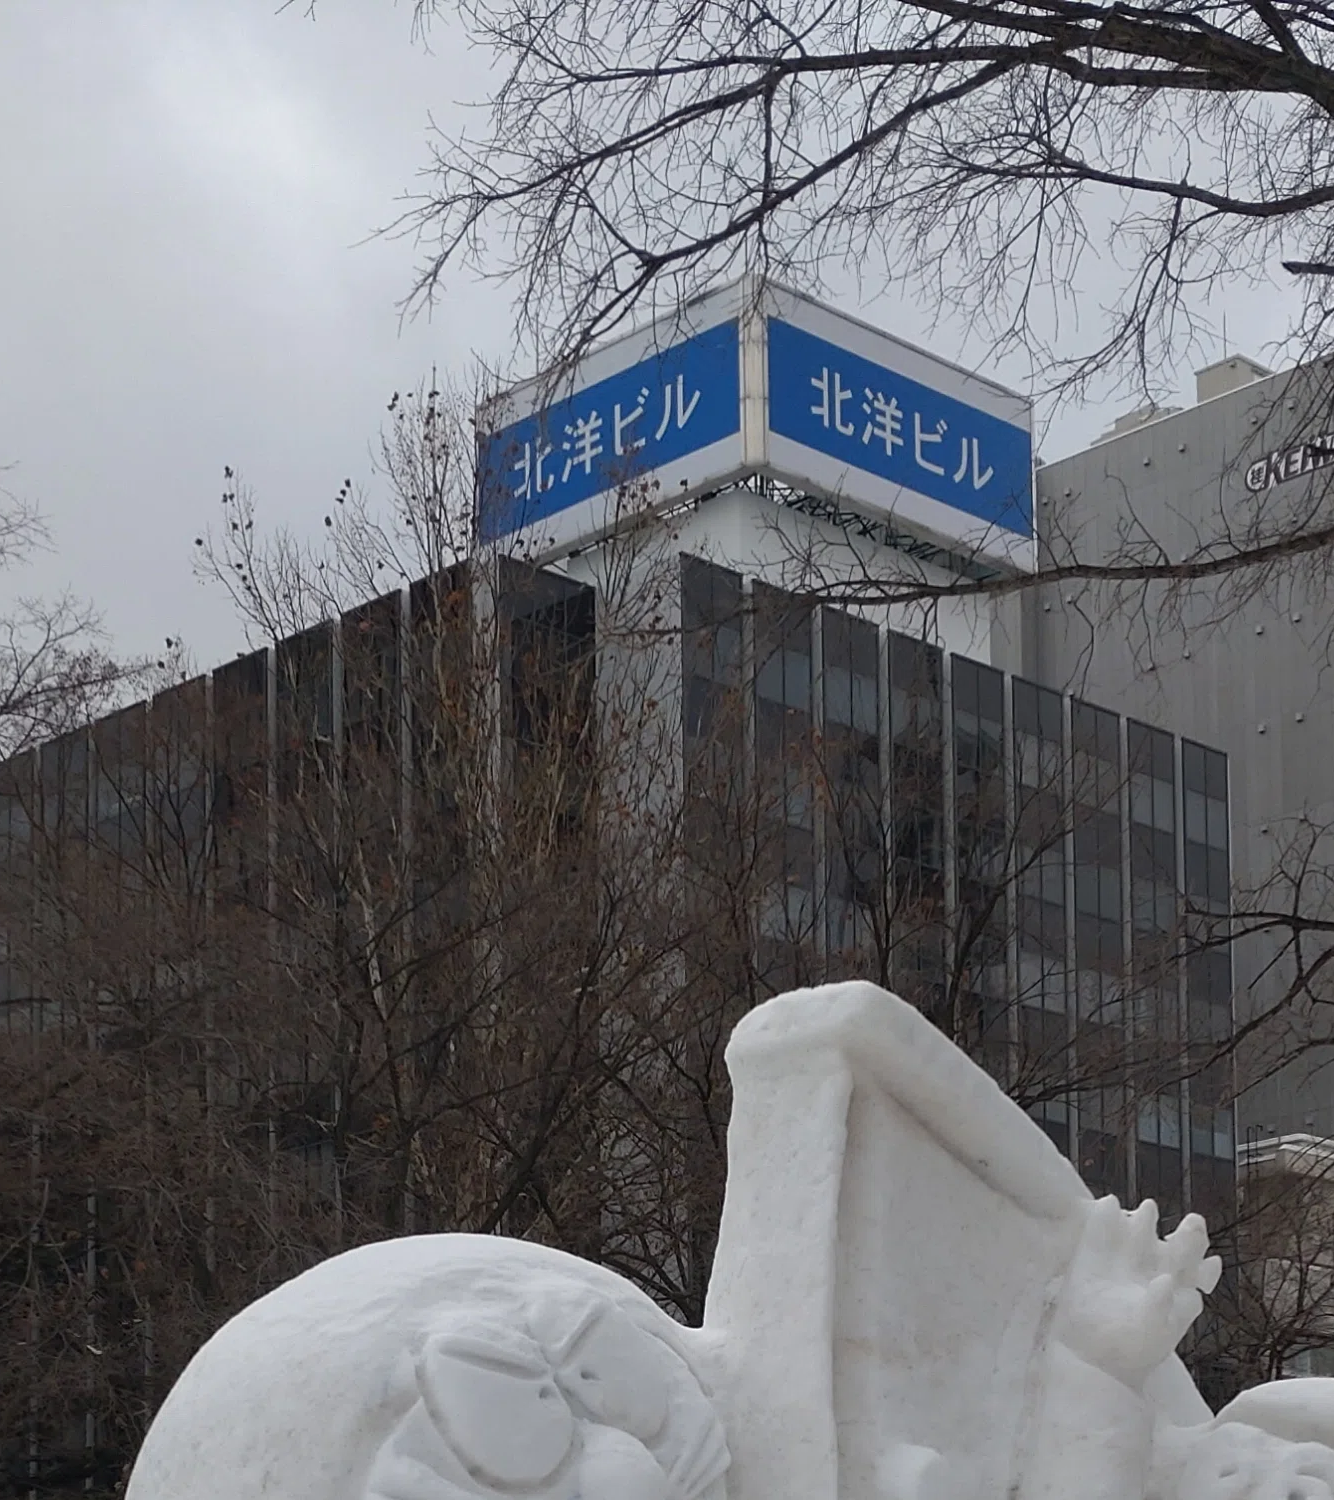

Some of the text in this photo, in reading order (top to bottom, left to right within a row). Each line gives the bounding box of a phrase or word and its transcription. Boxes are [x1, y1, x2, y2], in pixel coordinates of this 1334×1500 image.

[513, 374, 701, 500] 北洋ビル
[810, 366, 994, 491] 北洋ビル
